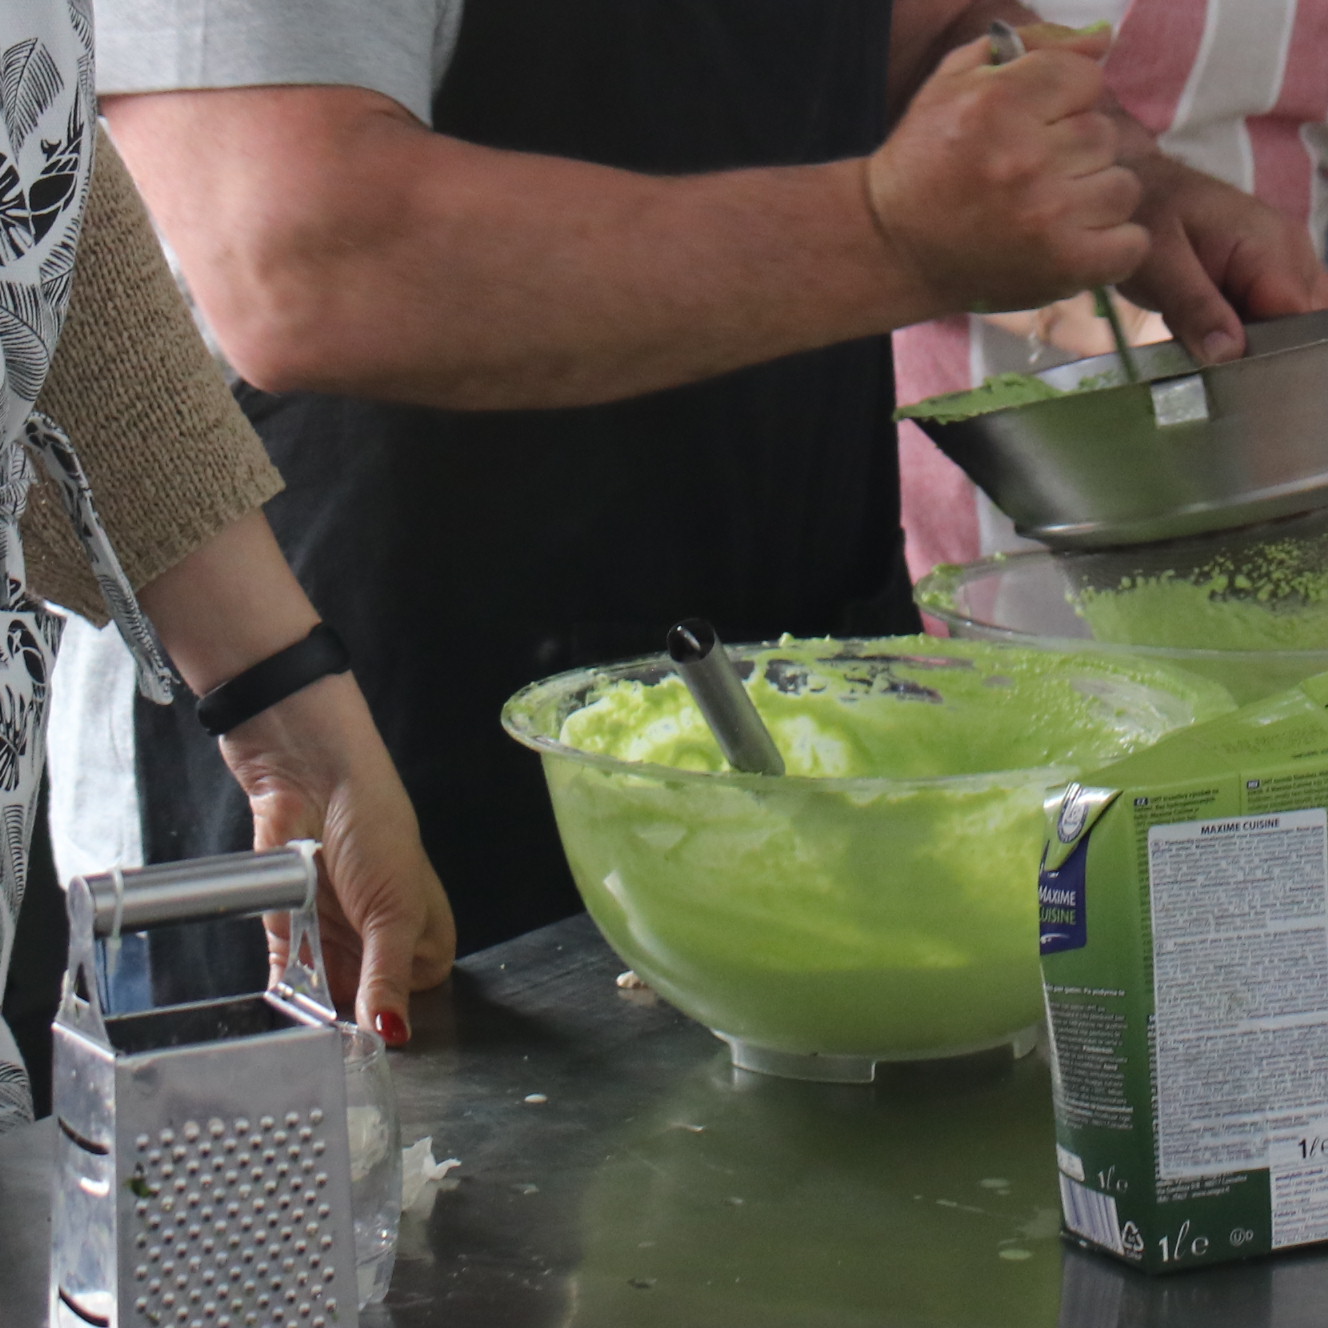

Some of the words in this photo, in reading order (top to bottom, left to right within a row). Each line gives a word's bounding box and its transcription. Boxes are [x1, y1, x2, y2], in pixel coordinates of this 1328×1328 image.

[1200, 821, 1241, 835] MAXIME
[1243, 817, 1280, 831] CUISINE
[1039, 885, 1076, 906] MAXIME
